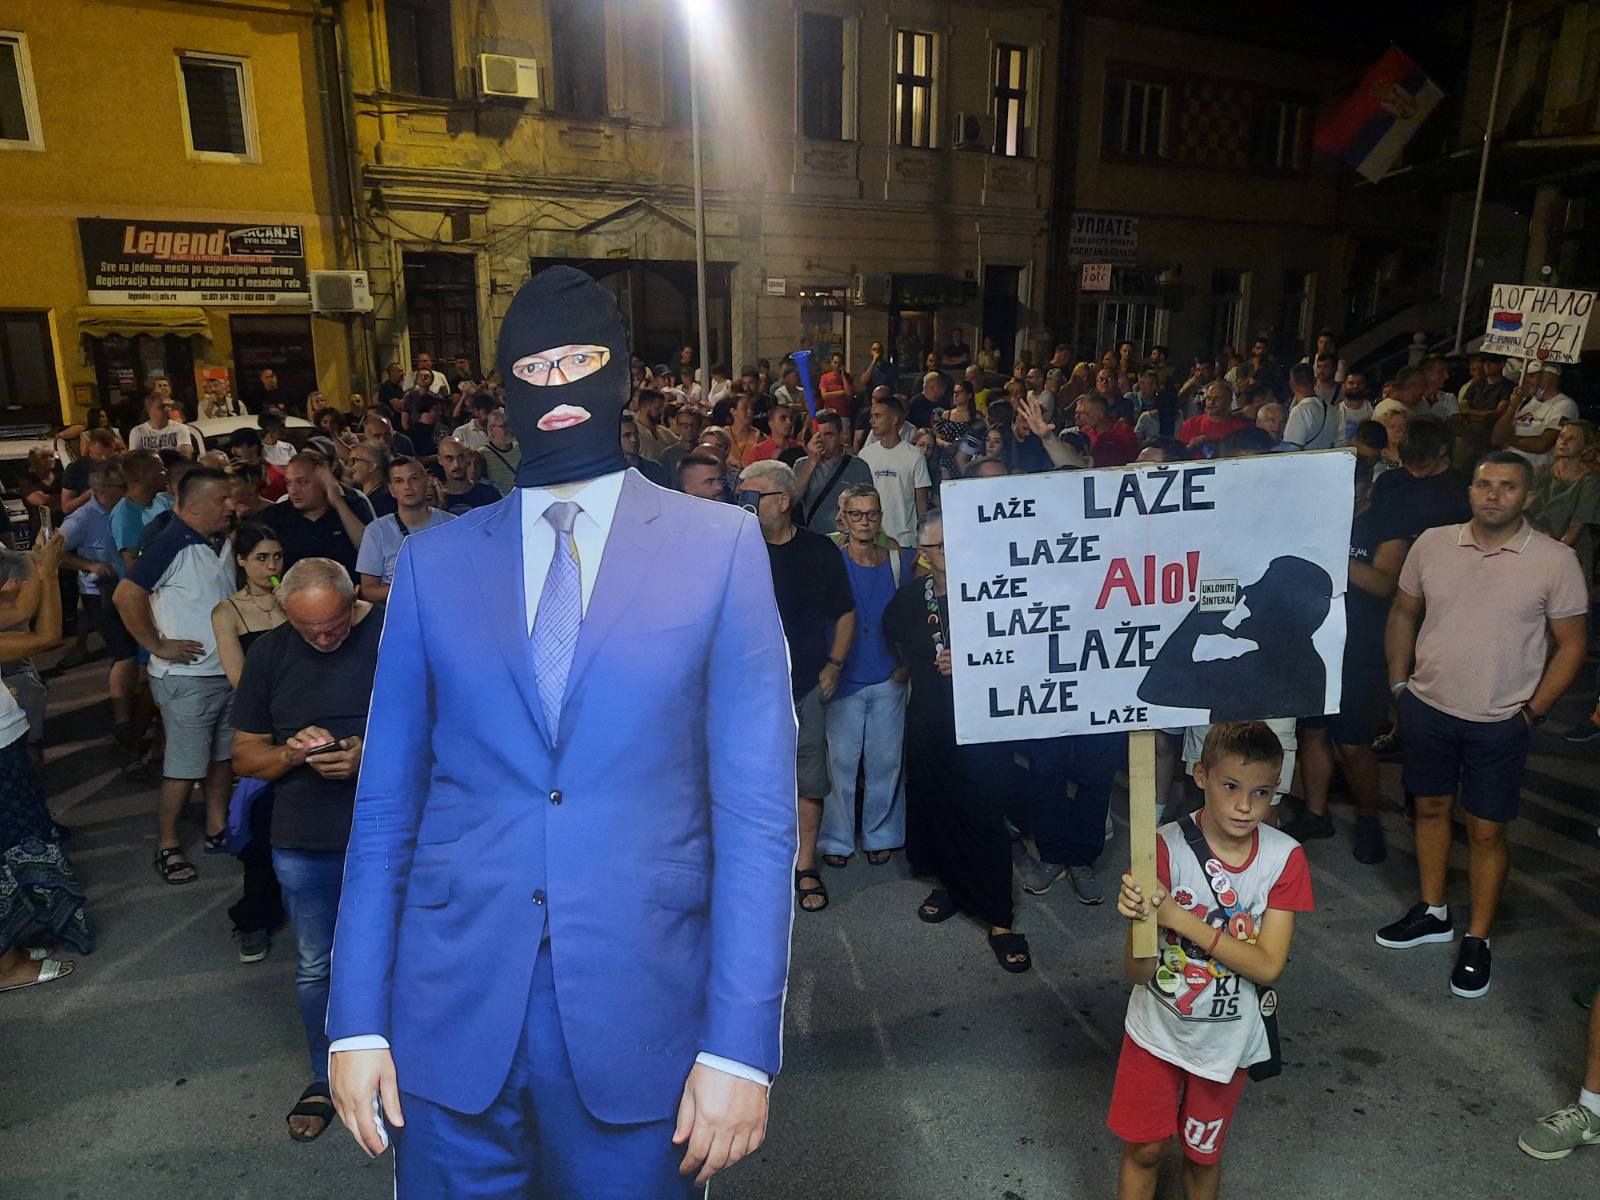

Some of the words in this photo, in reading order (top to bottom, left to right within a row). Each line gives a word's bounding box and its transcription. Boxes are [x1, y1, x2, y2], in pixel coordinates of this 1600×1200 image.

[123, 224, 225, 259] Legend
[96, 275, 148, 287] Registracija
[101, 261, 117, 272] Sve
[119, 263, 130, 273] na
[131, 262, 162, 274] jednom
[1490, 287, 1593, 317] ДОГНАЛО
[978, 497, 1037, 524] LAŽE
[1083, 465, 1215, 521] LAŽE
[1010, 532, 1101, 567] LAŽE
[960, 574, 1028, 603] LAŽE
[1094, 551, 1200, 609] Alo!
[1202, 583, 1236, 594] UKLONITE
[1201, 595, 1235, 606] ŠINTERAJ
[987, 602, 1071, 638] LAŽE
[968, 649, 1015, 667] LAŽE
[1048, 621, 1161, 674] LAŽE
[988, 679, 1079, 718] LAŽE
[1091, 704, 1149, 726] LAŽE
[1208, 997, 1240, 1018] DS
